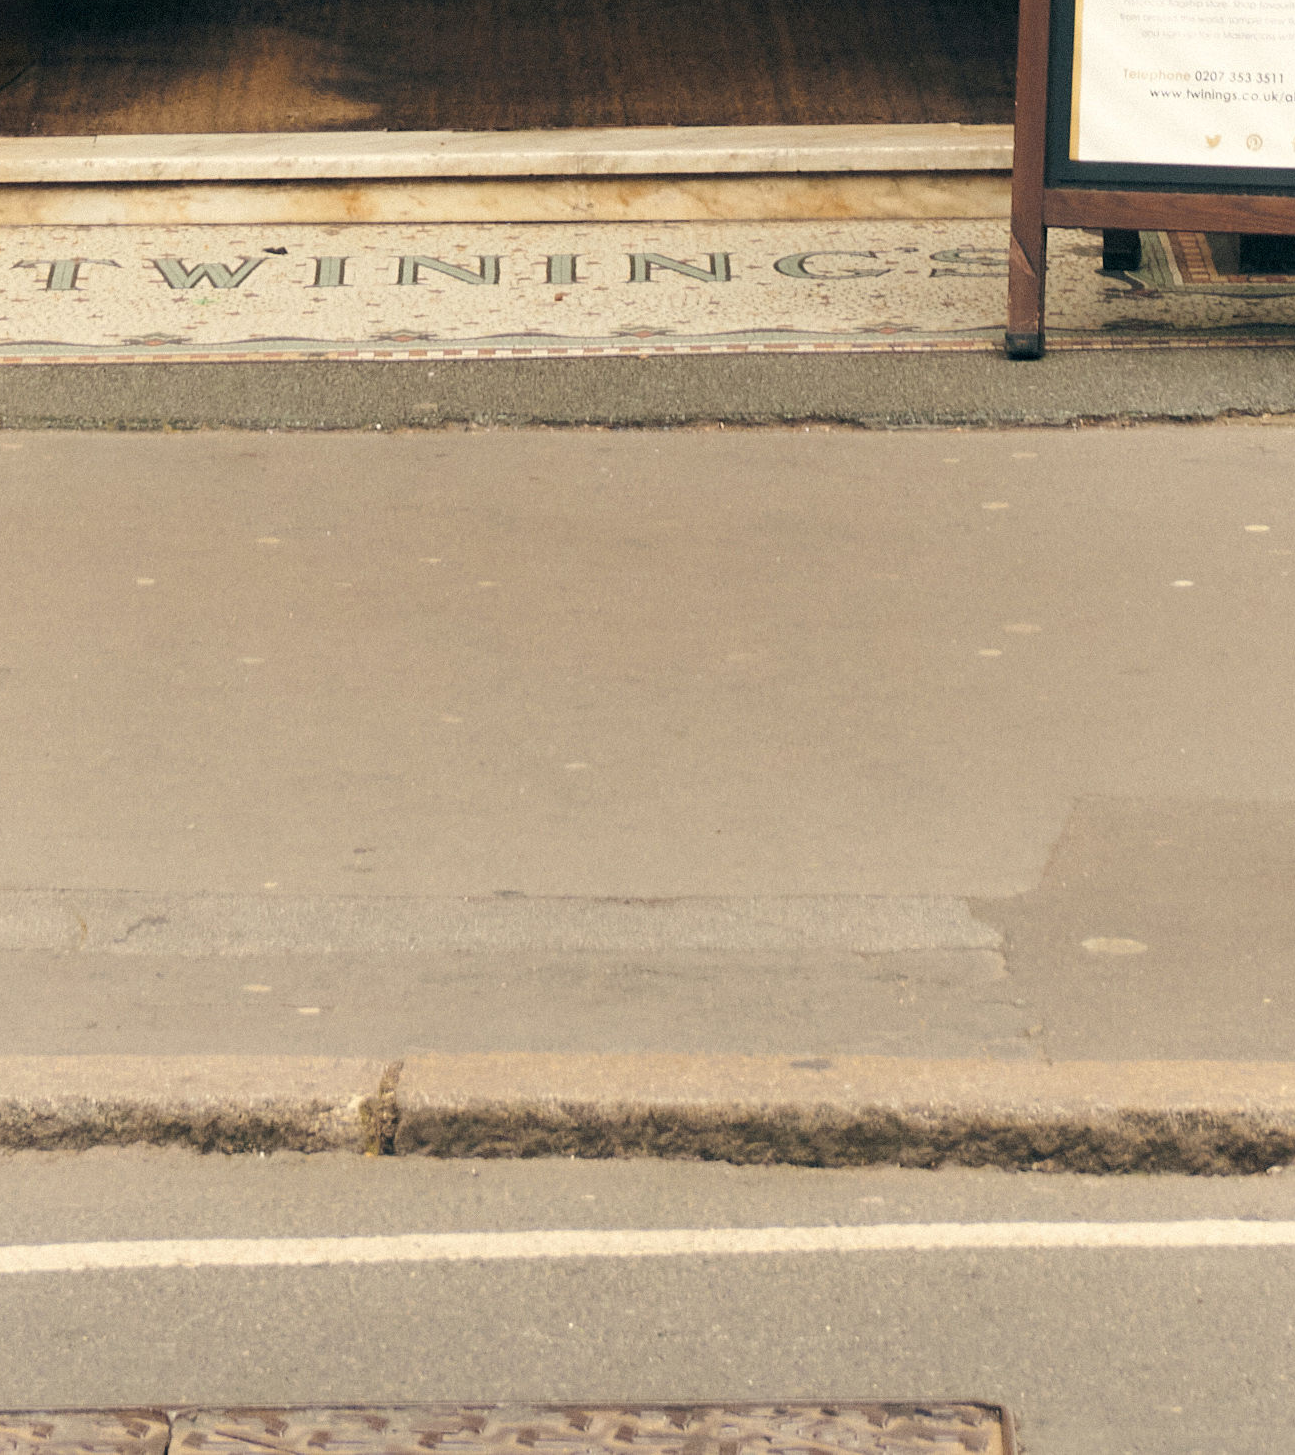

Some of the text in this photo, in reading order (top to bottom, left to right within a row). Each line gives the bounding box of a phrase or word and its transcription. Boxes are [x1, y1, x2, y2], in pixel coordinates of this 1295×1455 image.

[1123, 68, 1191, 83] Telephone
[1195, 70, 1225, 83] 0207
[1229, 72, 1252, 84] 353
[1256, 72, 1285, 84] 3511
